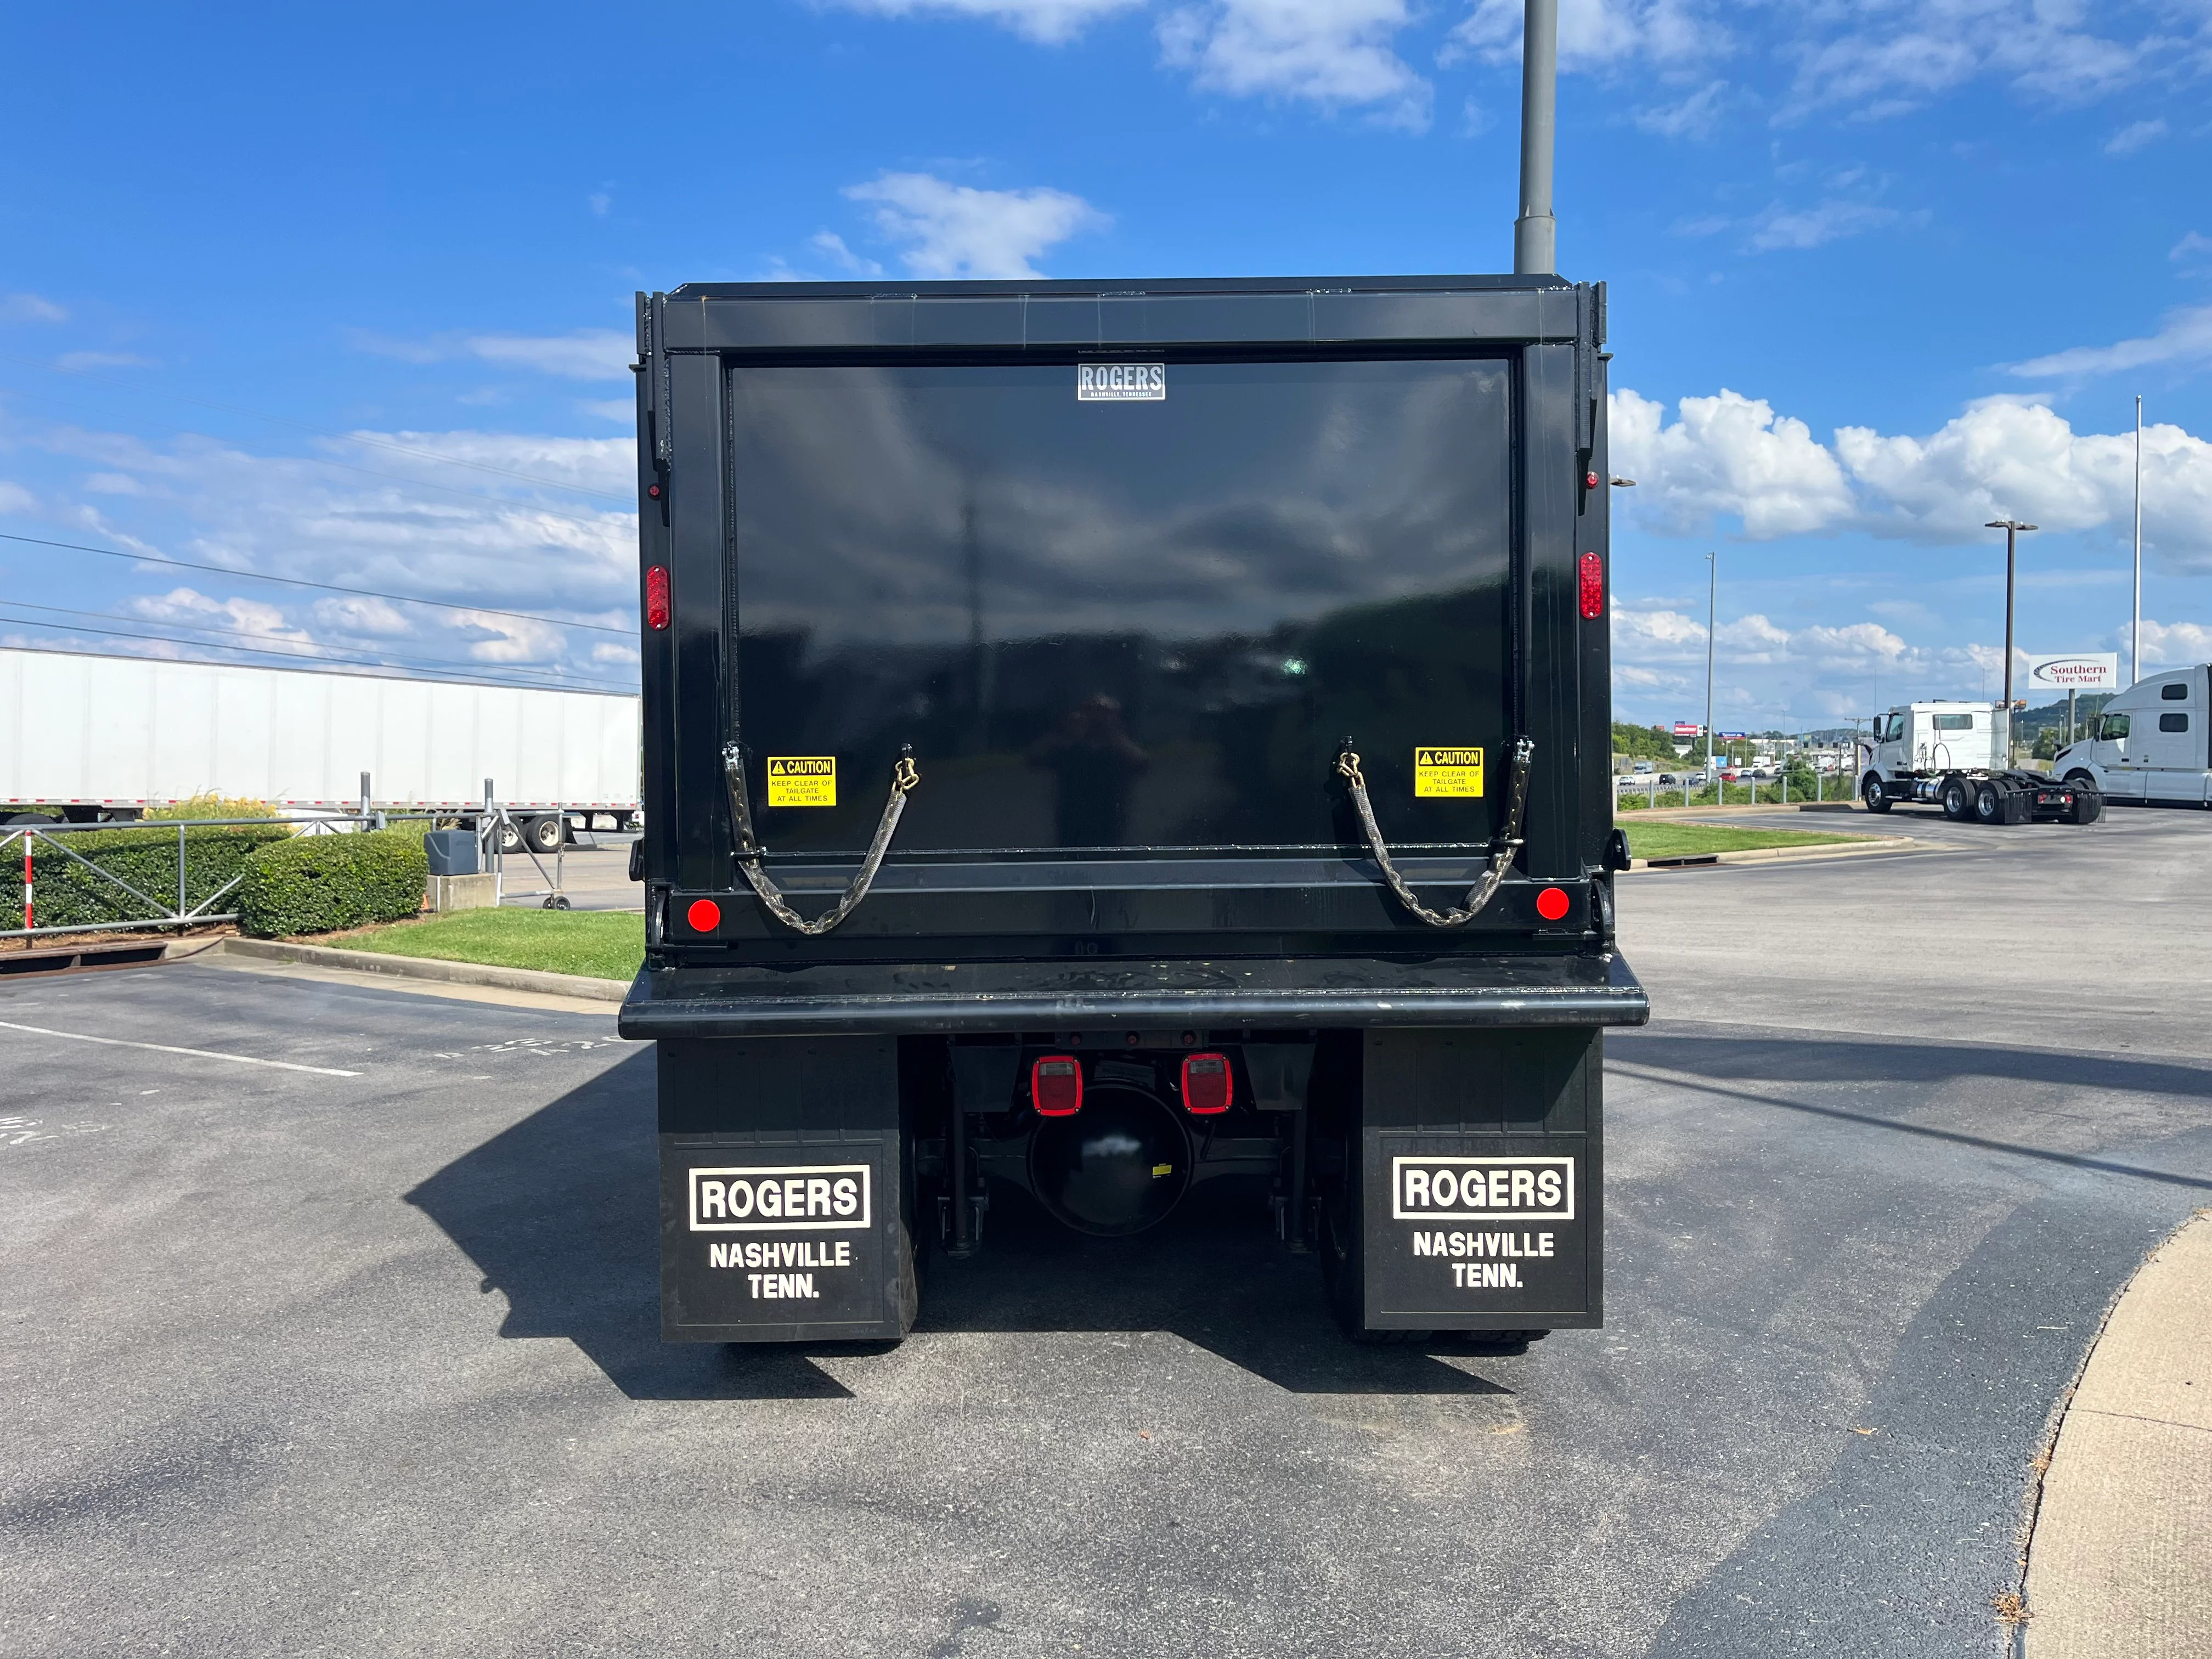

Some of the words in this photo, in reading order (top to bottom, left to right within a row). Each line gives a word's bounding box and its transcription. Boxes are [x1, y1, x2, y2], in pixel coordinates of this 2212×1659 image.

[1081, 366, 1162, 391] ROGERS
[2050, 665, 2107, 675] Southern
[787, 760, 831, 774] CAUTION
[1435, 751, 1479, 764] CAUTION
[702, 1178, 857, 1217] ROGERS
[1406, 1169, 1561, 1207] ROGERS
[710, 1242, 850, 1267] NASHVILLE
[1414, 1232, 1554, 1257] NASHVILLE
[748, 1273, 819, 1299] TENN.
[1452, 1263, 1523, 1288] TENN.
